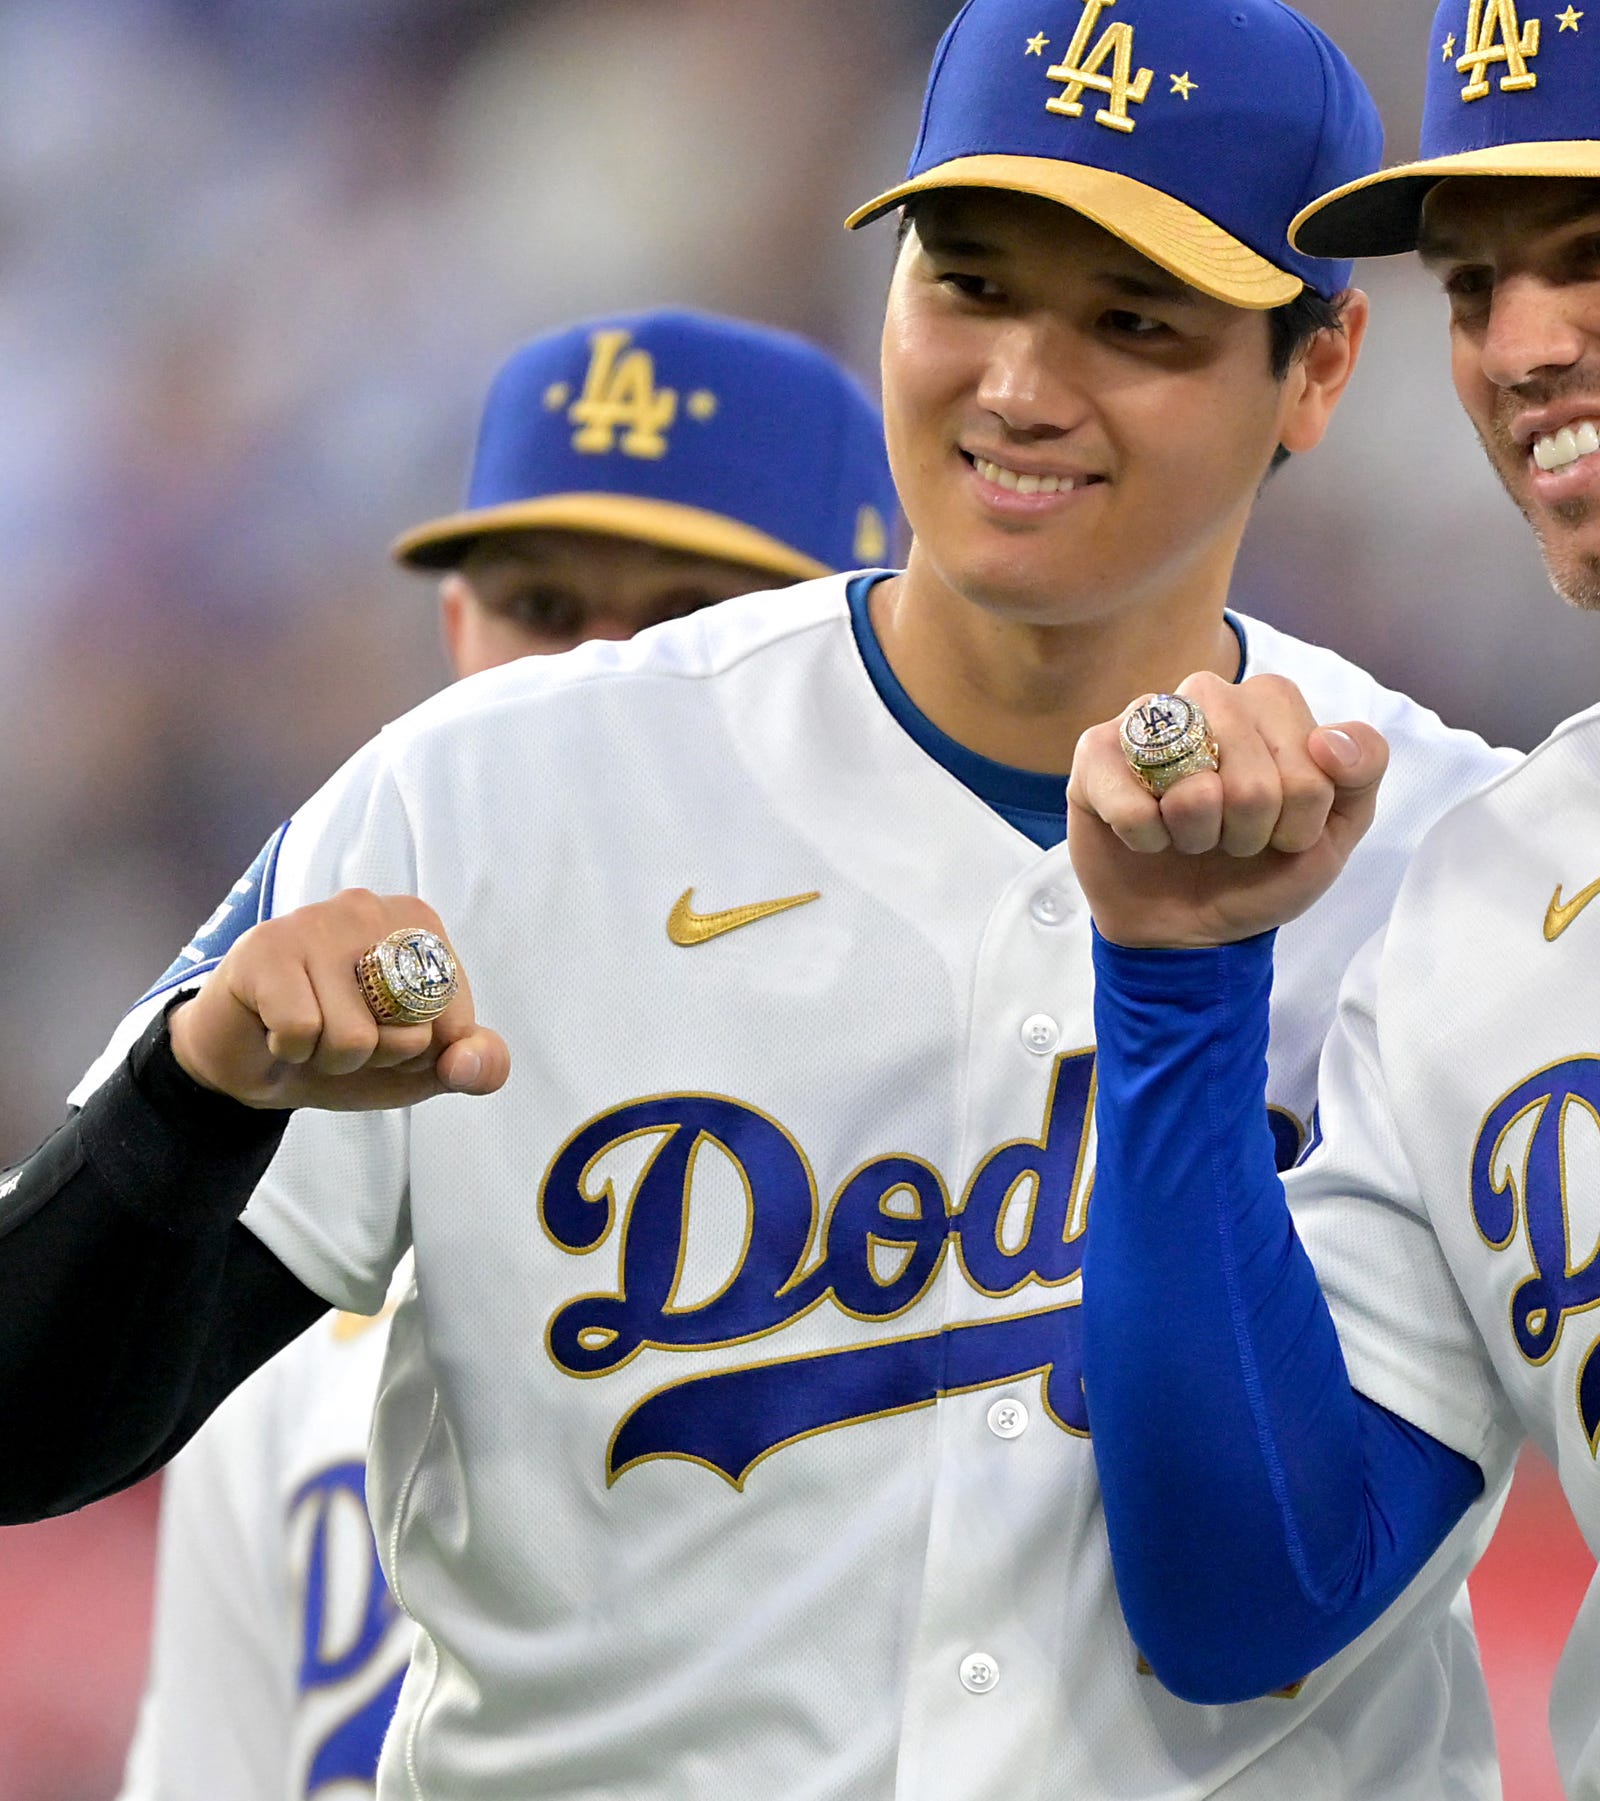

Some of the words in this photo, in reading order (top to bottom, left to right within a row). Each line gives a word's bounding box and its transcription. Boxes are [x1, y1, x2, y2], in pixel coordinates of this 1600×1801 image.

[1046, 0, 1154, 133] LA
[1456, 0, 1540, 102] LA
[569, 330, 678, 460] LA
